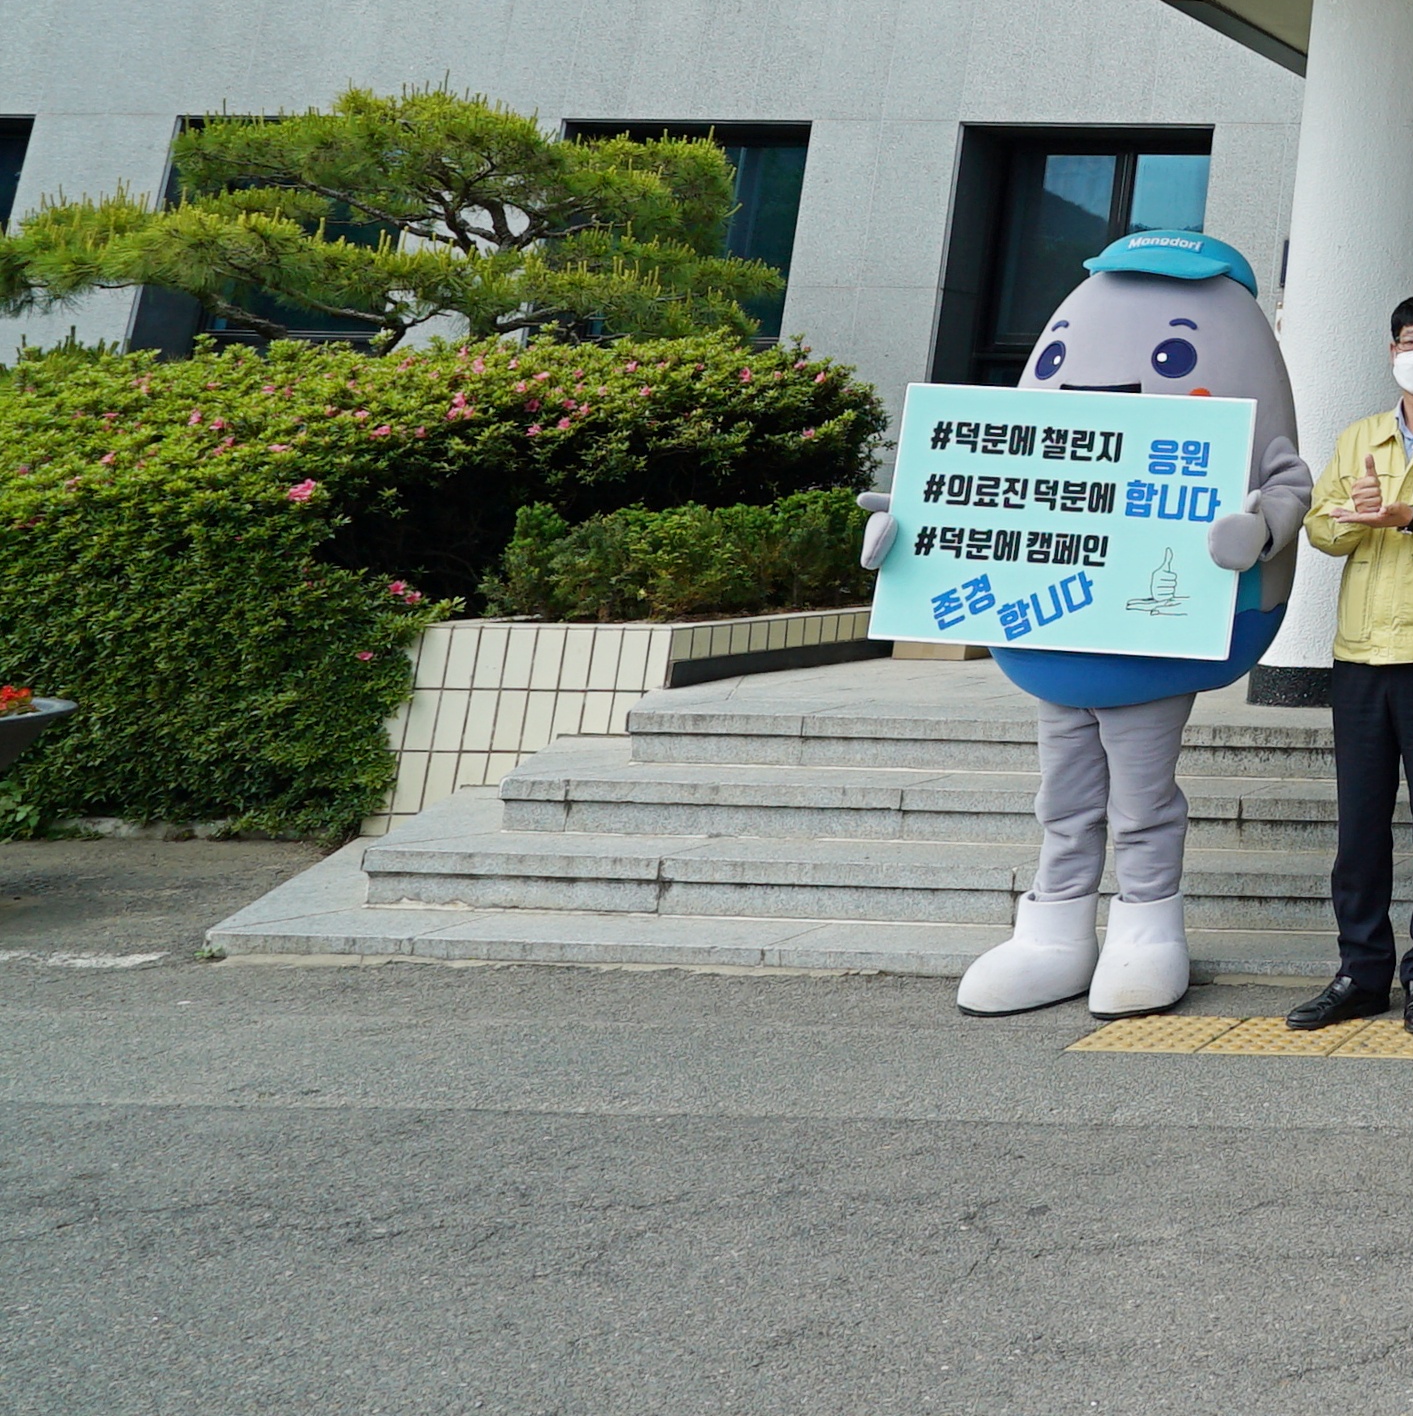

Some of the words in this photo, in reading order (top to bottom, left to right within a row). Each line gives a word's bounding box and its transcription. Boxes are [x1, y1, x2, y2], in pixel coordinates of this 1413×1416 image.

[930, 420, 1037, 457] #덕분에
[1041, 426, 1124, 464] 챌린지
[1147, 439, 1212, 477] 응원
[922, 473, 1028, 510] #의료진
[1033, 477, 1115, 514] 덕분에
[1124, 479, 1222, 523] 합니다
[913, 526, 1020, 563] #덕분에
[1025, 531, 1110, 568] 캠페인
[930, 573, 997, 631] 존경
[996, 570, 1095, 642] 합니다
